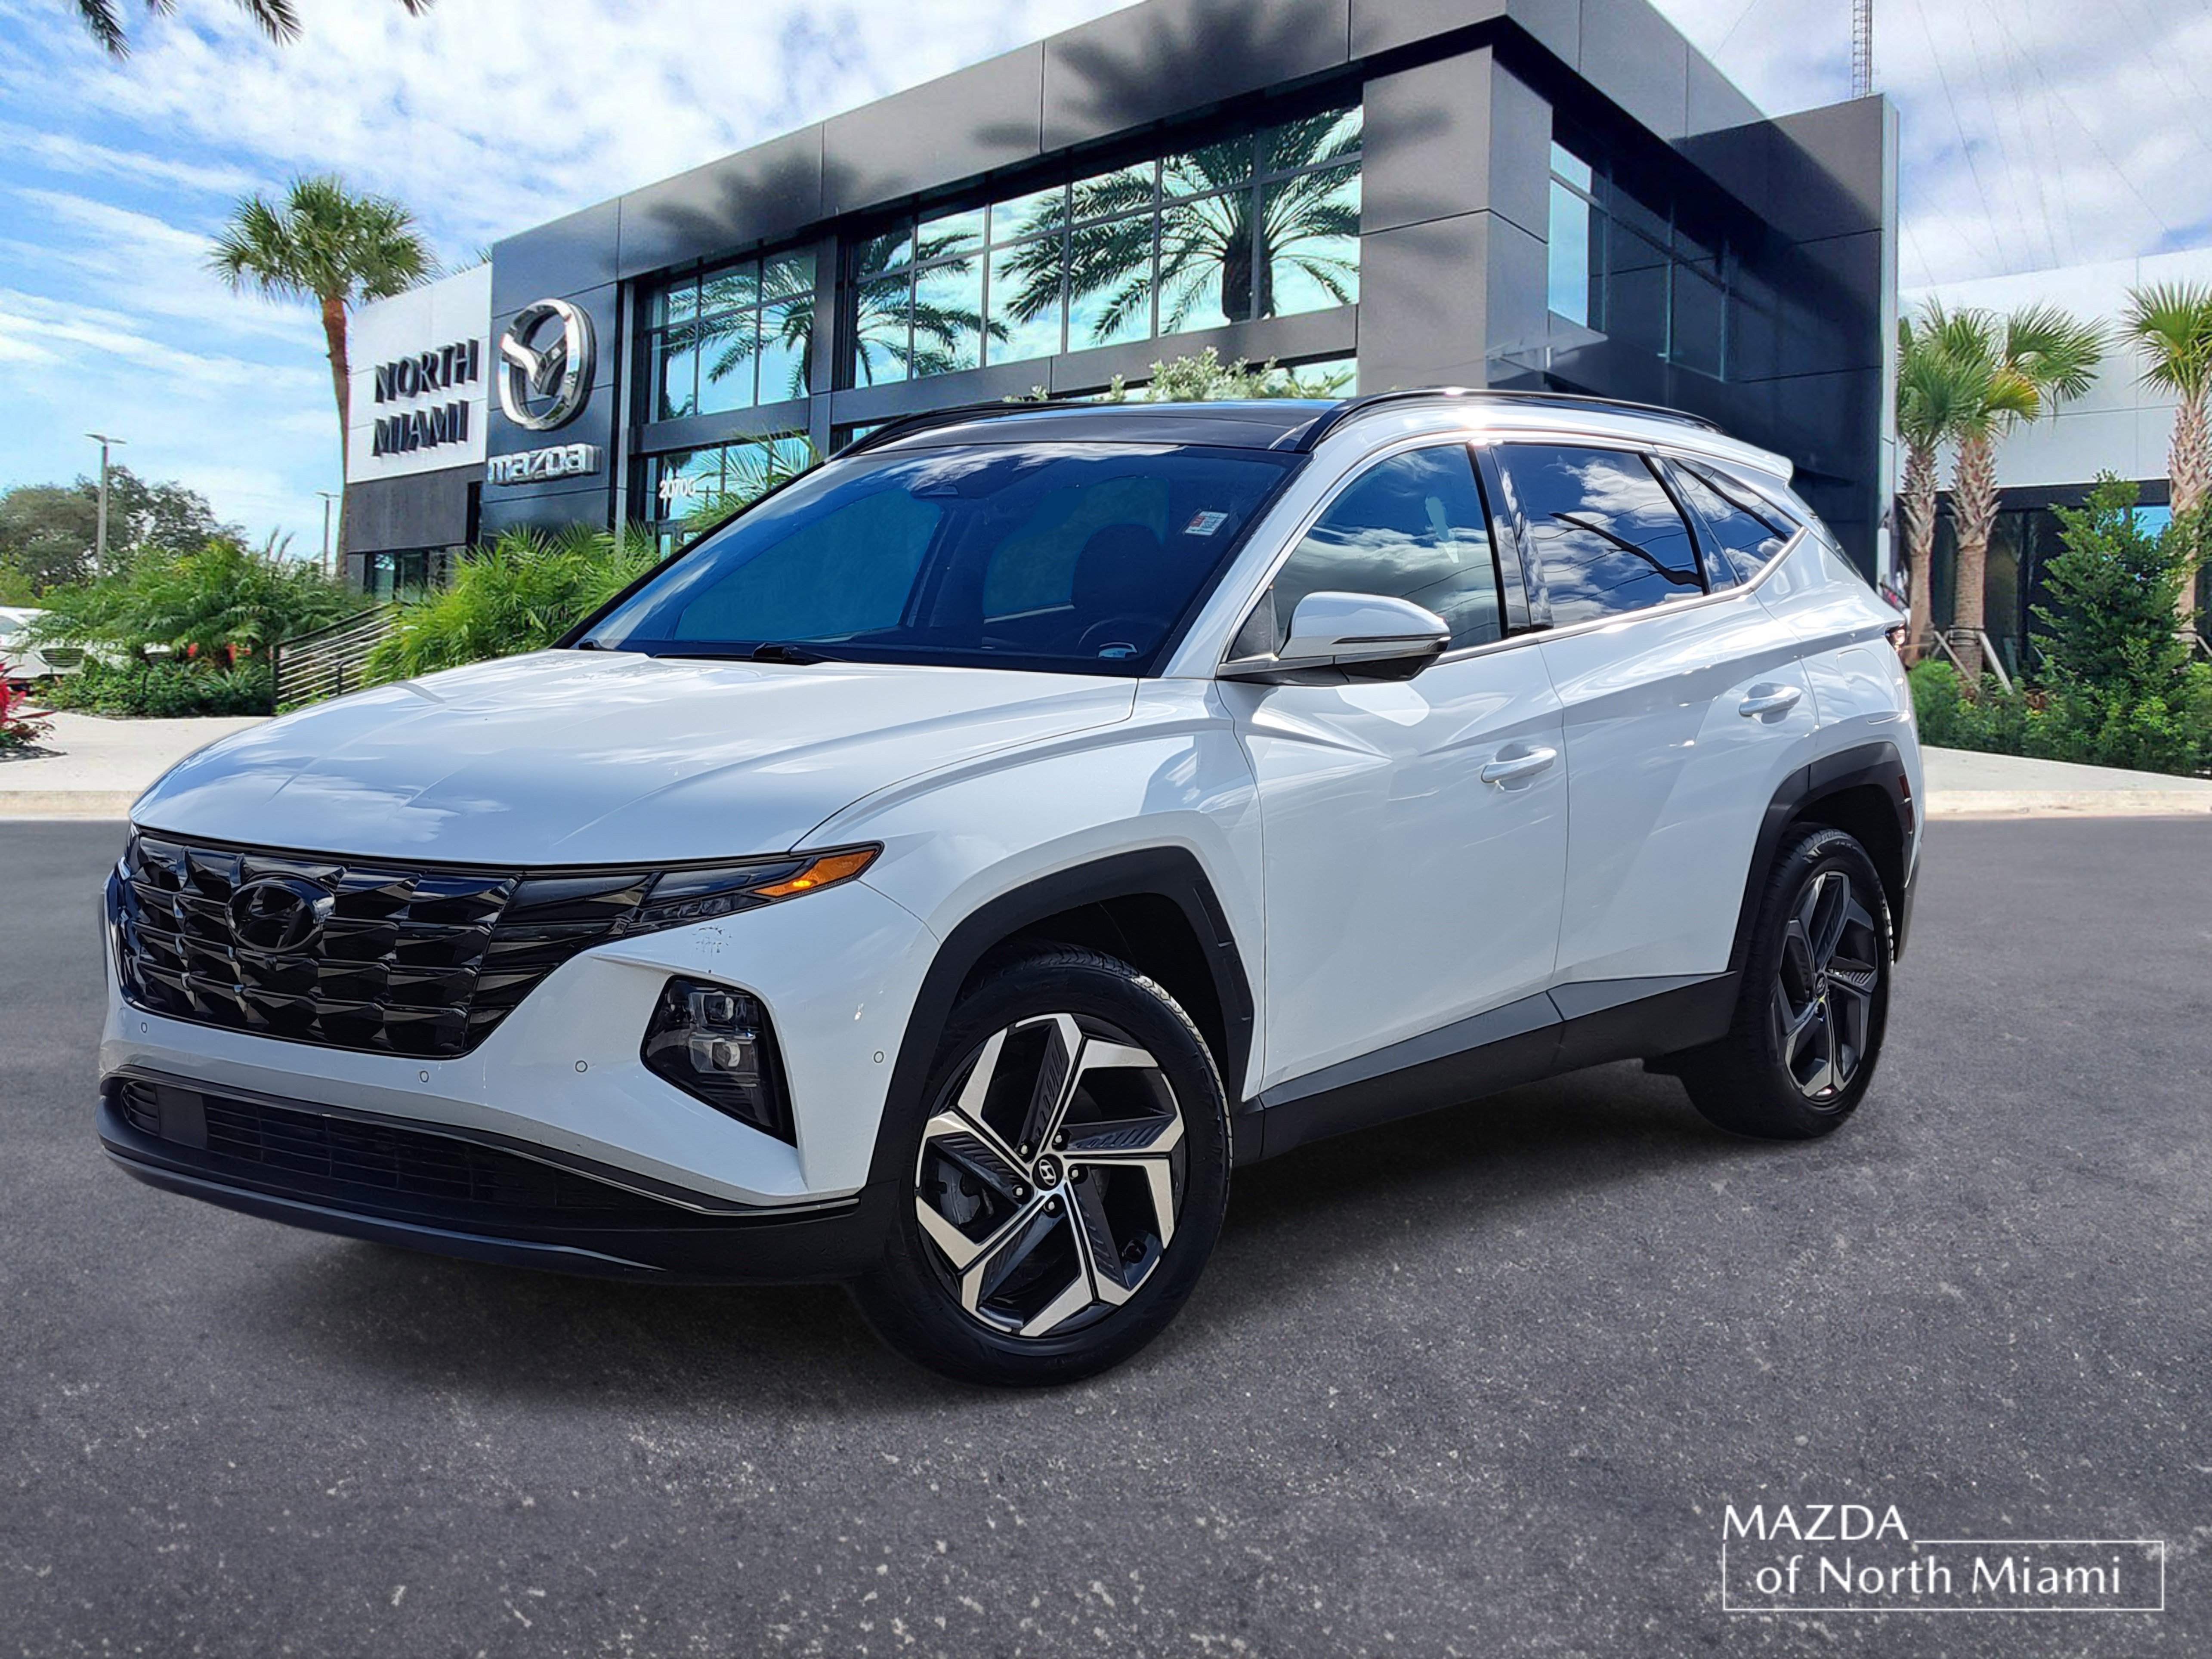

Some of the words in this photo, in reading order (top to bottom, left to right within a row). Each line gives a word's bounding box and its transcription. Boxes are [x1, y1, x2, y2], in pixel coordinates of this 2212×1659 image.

[375, 339, 479, 403] NORTH
[373, 401, 468, 456] MIAMI
[488, 443, 599, 484] mazda
